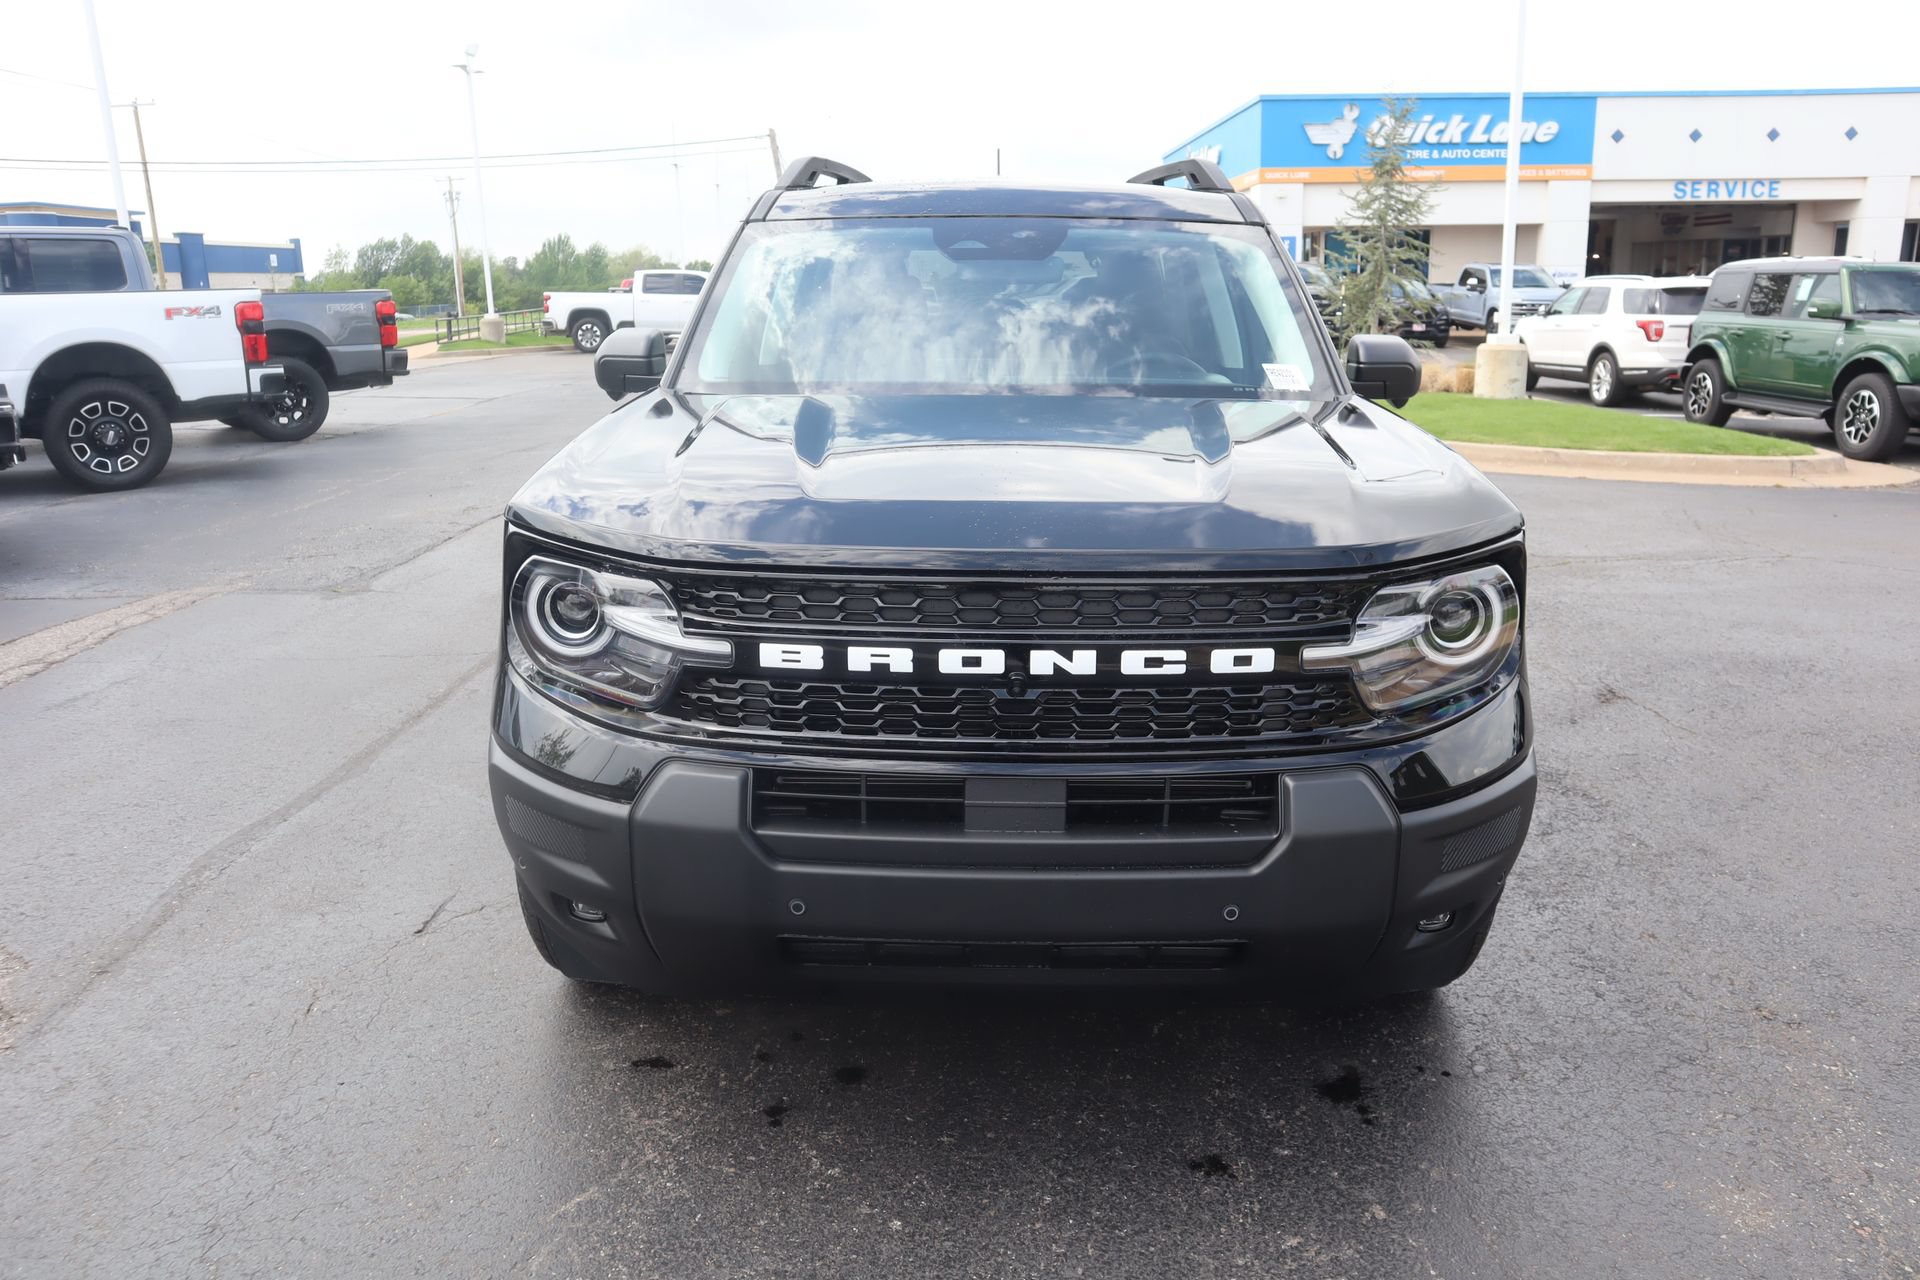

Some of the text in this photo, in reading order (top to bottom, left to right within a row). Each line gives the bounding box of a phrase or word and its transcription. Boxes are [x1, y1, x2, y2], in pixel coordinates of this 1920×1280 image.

[1441, 149, 1470, 159] AUTO
[1472, 148, 1509, 159] CENTE
[1673, 179, 1781, 199] SERVICE
[164, 304, 222, 320] FX4
[758, 642, 1275, 676] BRONCO
